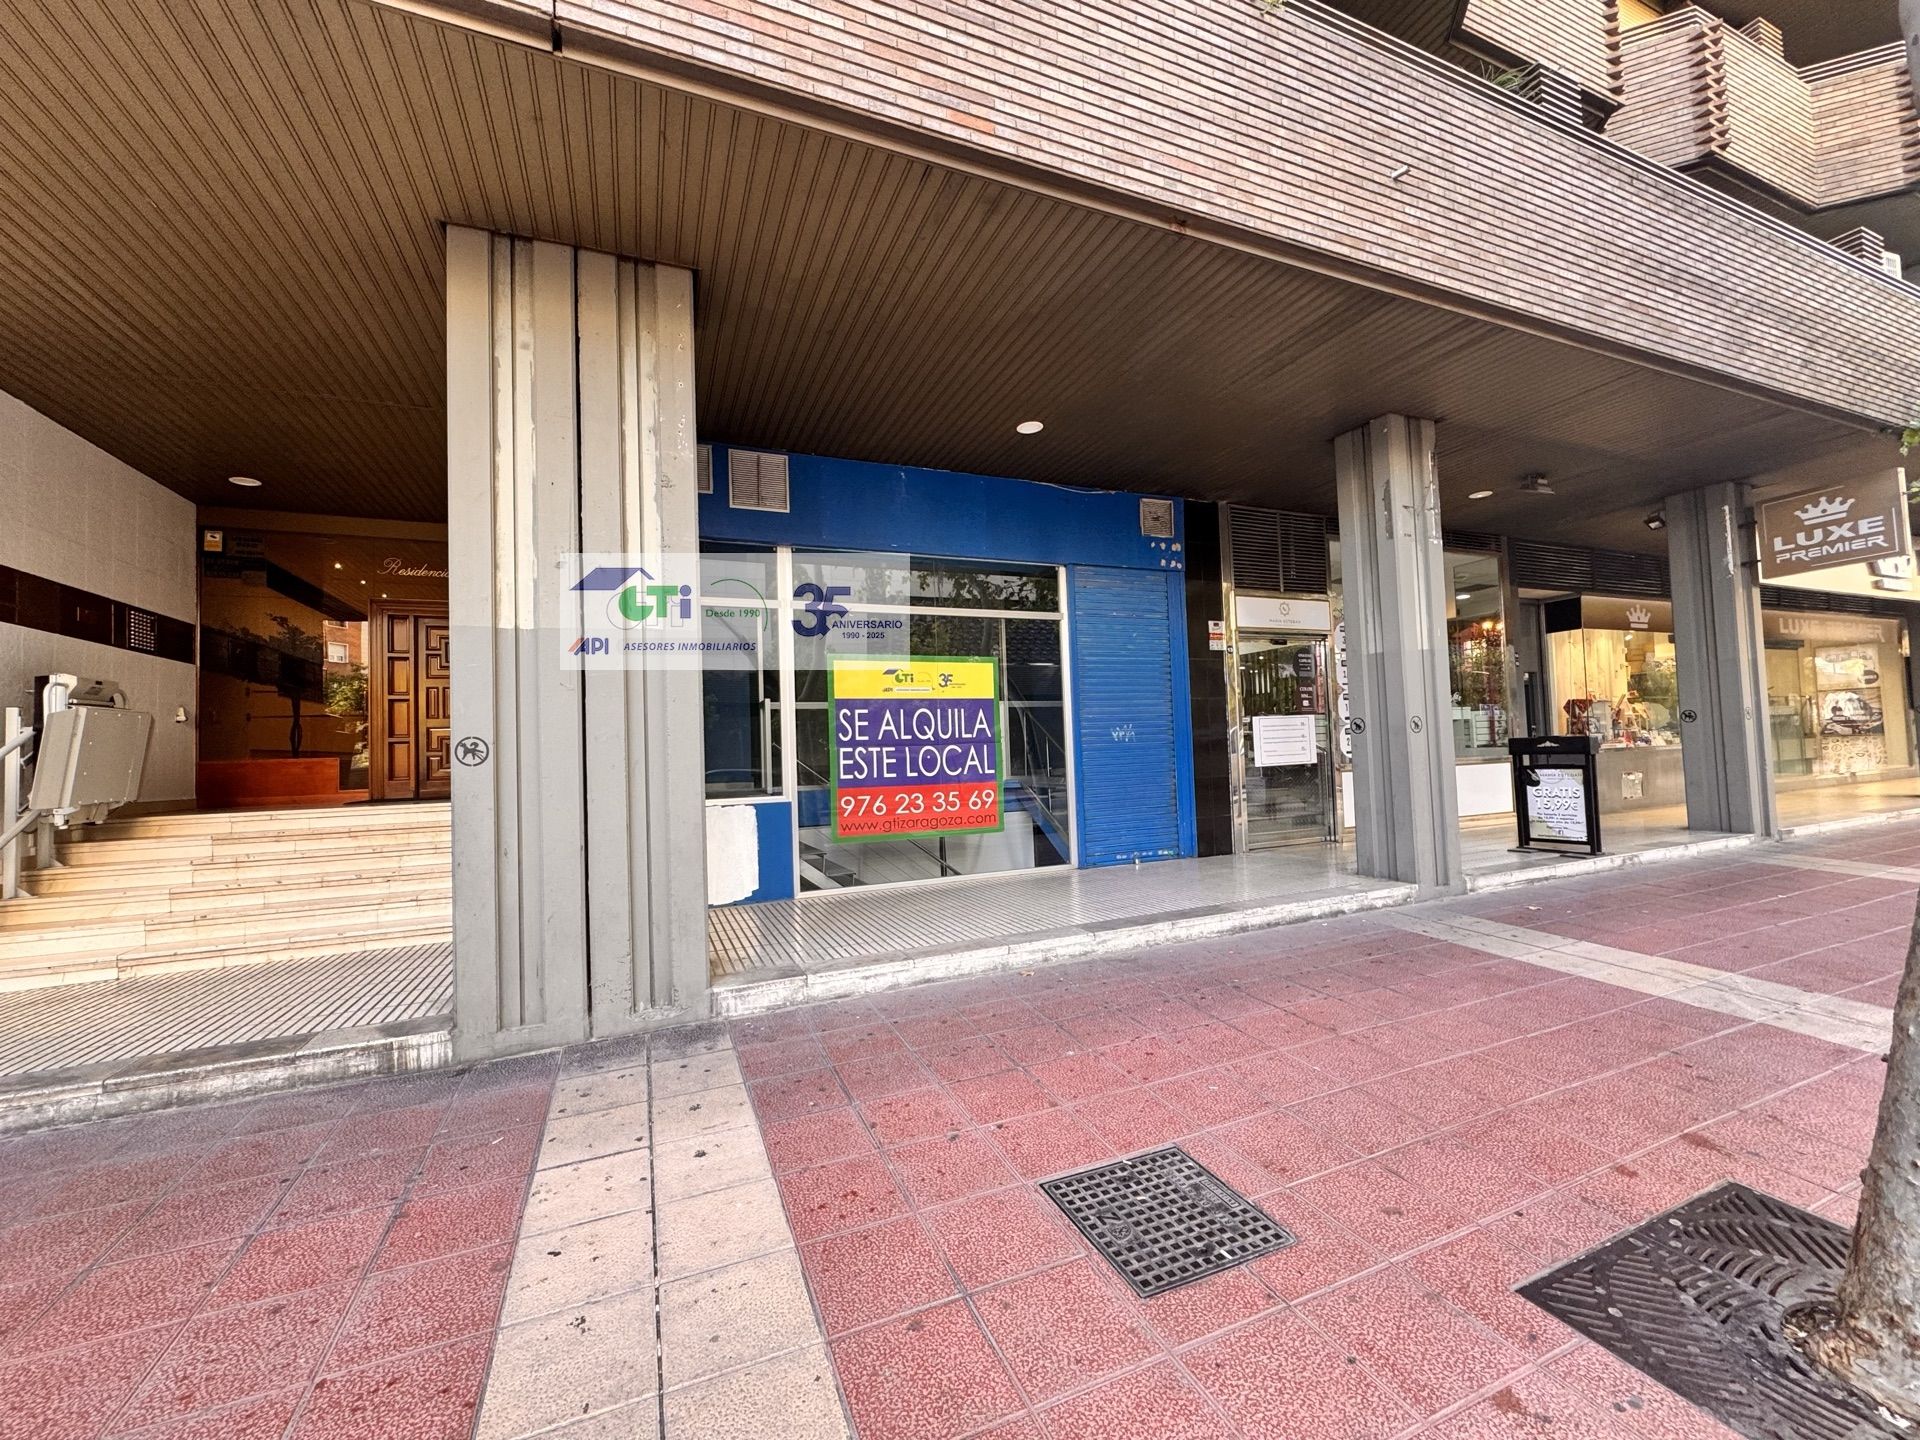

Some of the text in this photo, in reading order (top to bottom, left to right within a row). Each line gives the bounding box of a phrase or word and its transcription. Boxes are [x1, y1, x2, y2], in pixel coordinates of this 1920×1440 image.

[1773, 515, 1886, 551] LUXE
[1775, 535, 1889, 564] PREMIER
[838, 708, 992, 741] SE ALQUILA
[839, 744, 995, 779] ESTE LOCAL
[840, 789, 995, 817] 976 23 35 69
[1532, 786, 1580, 799] GRATIS
[840, 812, 997, 833] www.gtizaragoza.com
